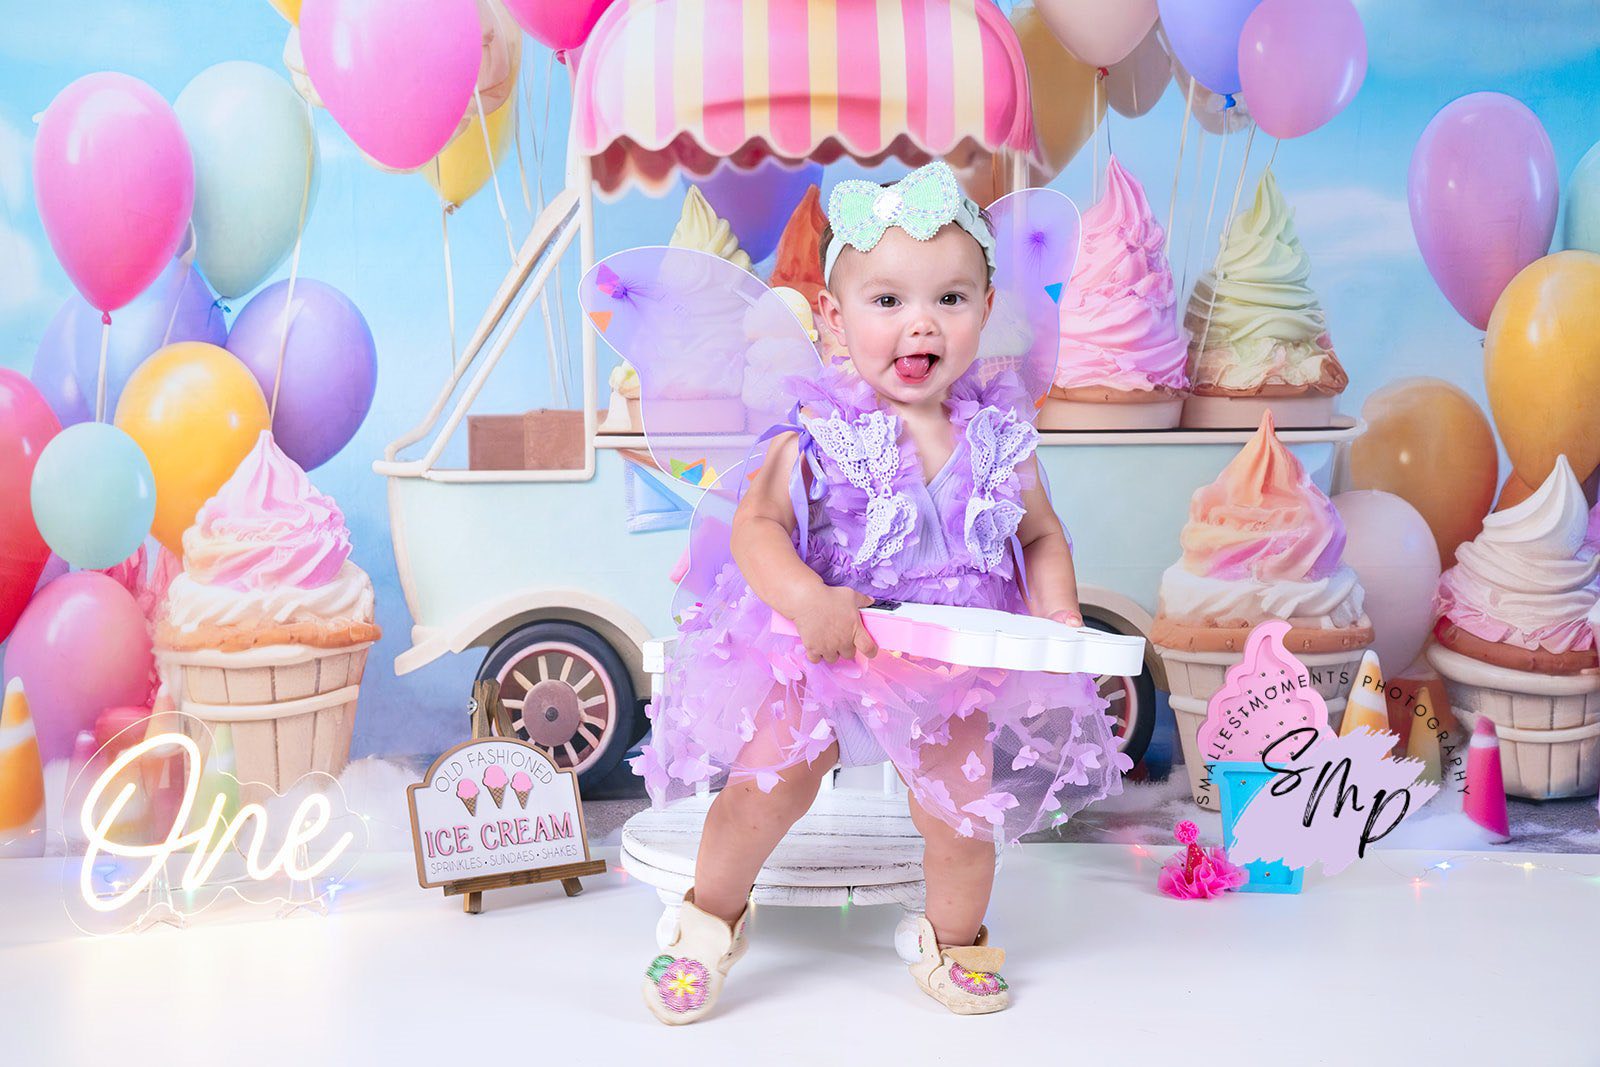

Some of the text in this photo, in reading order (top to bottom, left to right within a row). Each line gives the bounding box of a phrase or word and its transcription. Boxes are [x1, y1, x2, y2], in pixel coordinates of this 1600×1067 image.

[435, 749, 552, 792] OLD FASHIONED
[80, 733, 354, 912] One
[425, 812, 574, 858] ICE CREAM
[431, 845, 577, 875] SPRINKLES SUNDAES SHAKES
